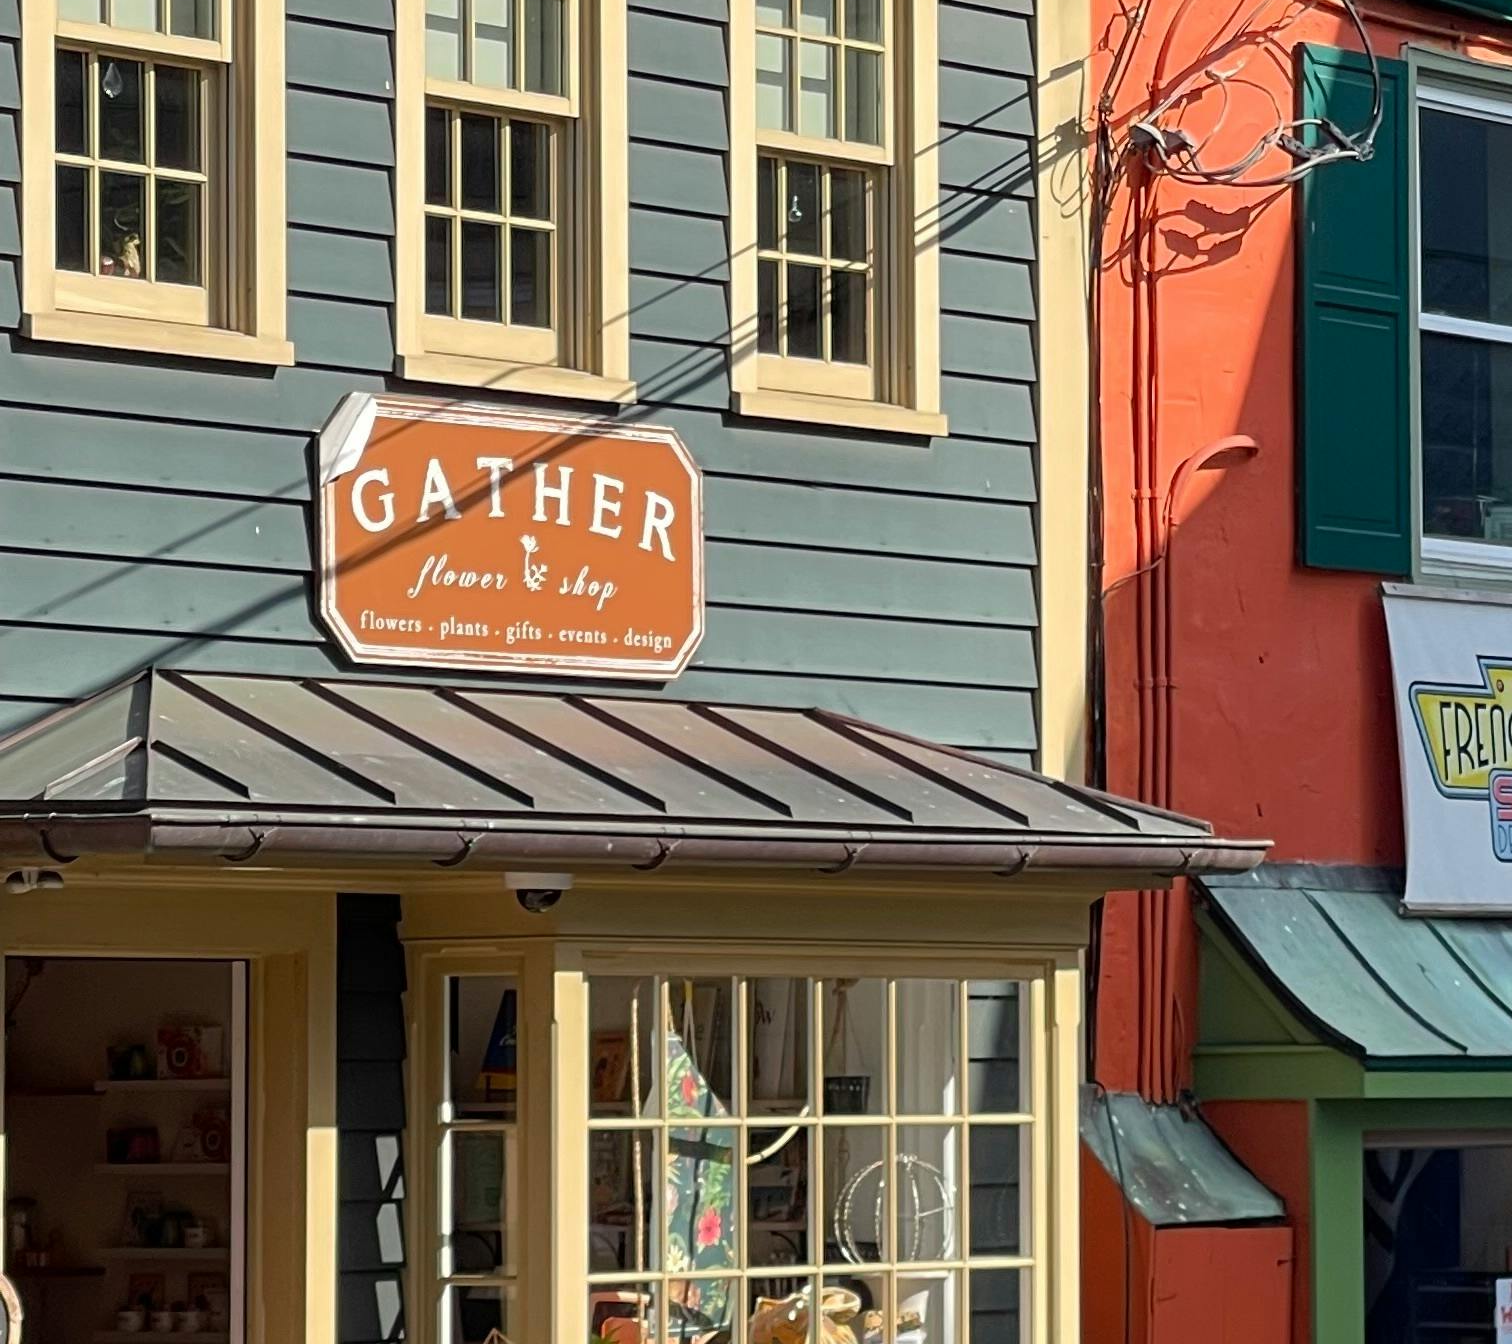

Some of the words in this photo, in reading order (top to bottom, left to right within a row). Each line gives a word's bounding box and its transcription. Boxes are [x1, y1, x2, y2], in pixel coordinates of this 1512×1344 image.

[351, 457, 676, 561] GATHER
[407, 555, 508, 599] flower
[559, 565, 619, 611] shop
[360, 610, 422, 632] flowers
[440, 616, 489, 640] plants
[506, 619, 542, 644] gifts
[559, 623, 607, 645] events
[623, 628, 673, 652] design
